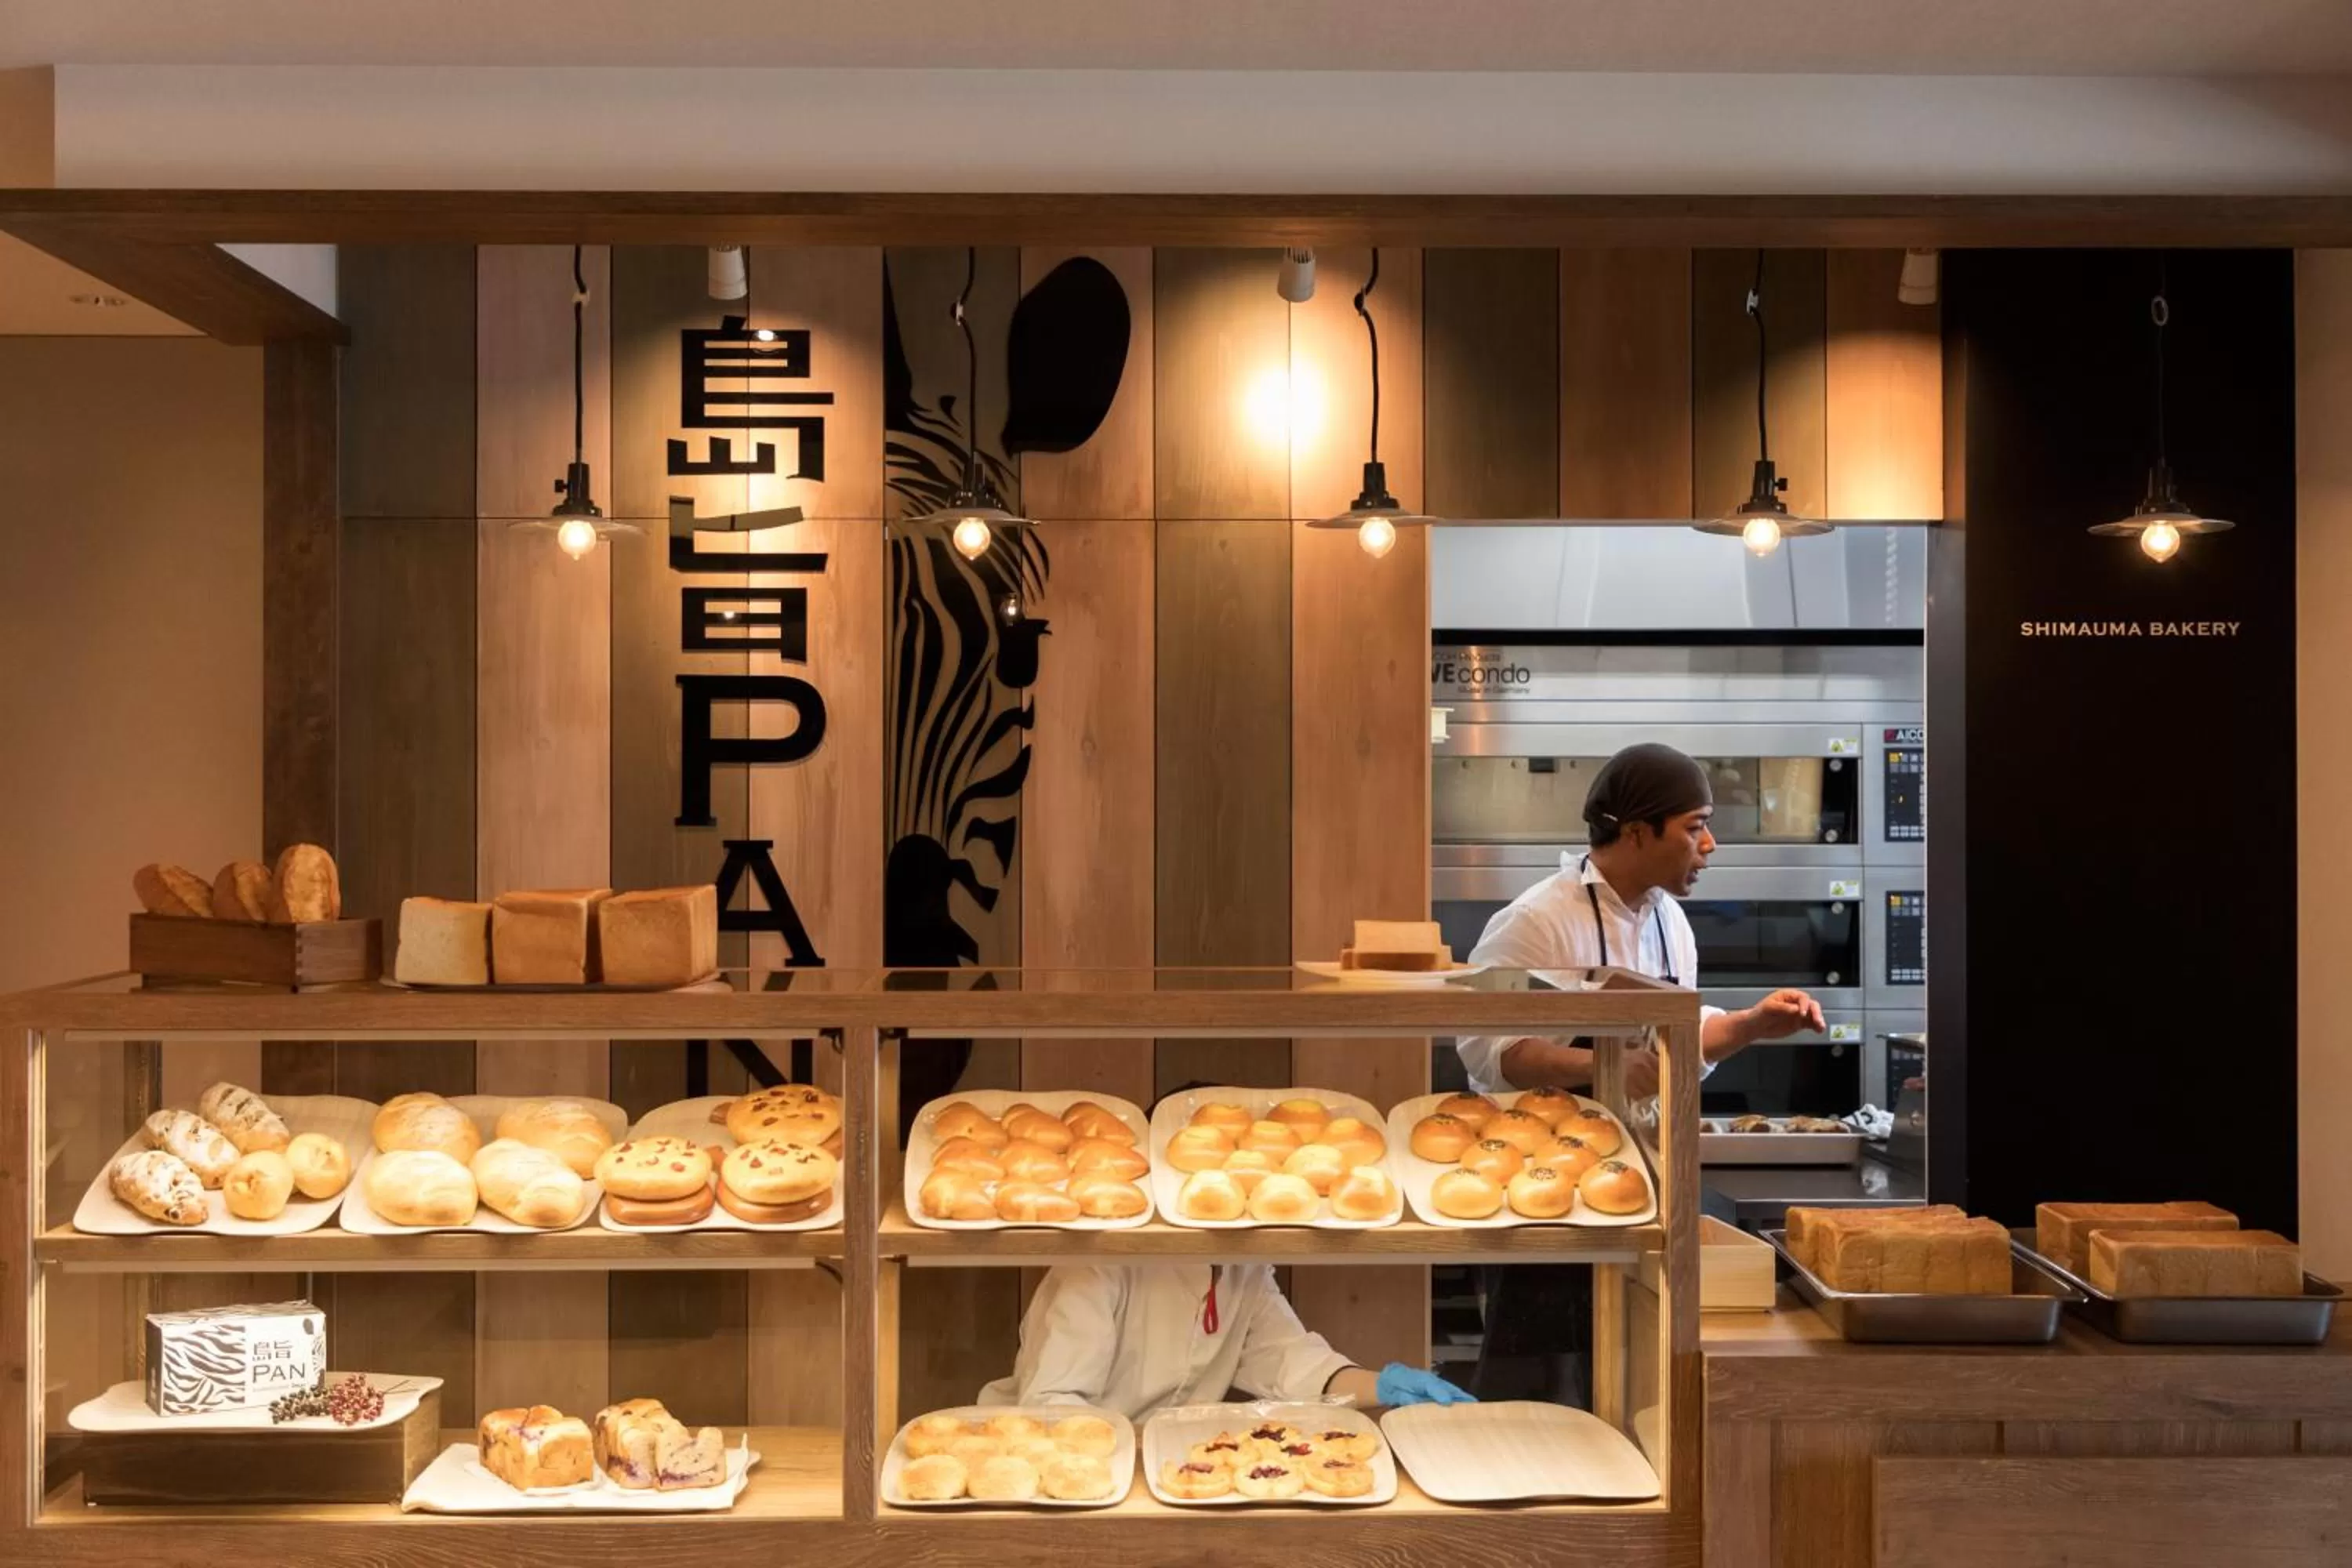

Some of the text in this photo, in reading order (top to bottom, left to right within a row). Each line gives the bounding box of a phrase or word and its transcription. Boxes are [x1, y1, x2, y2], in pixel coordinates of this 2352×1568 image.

[2020, 621, 2241, 637] SHIMAUMA BAKERY
[252, 1363, 306, 1384] PAN
